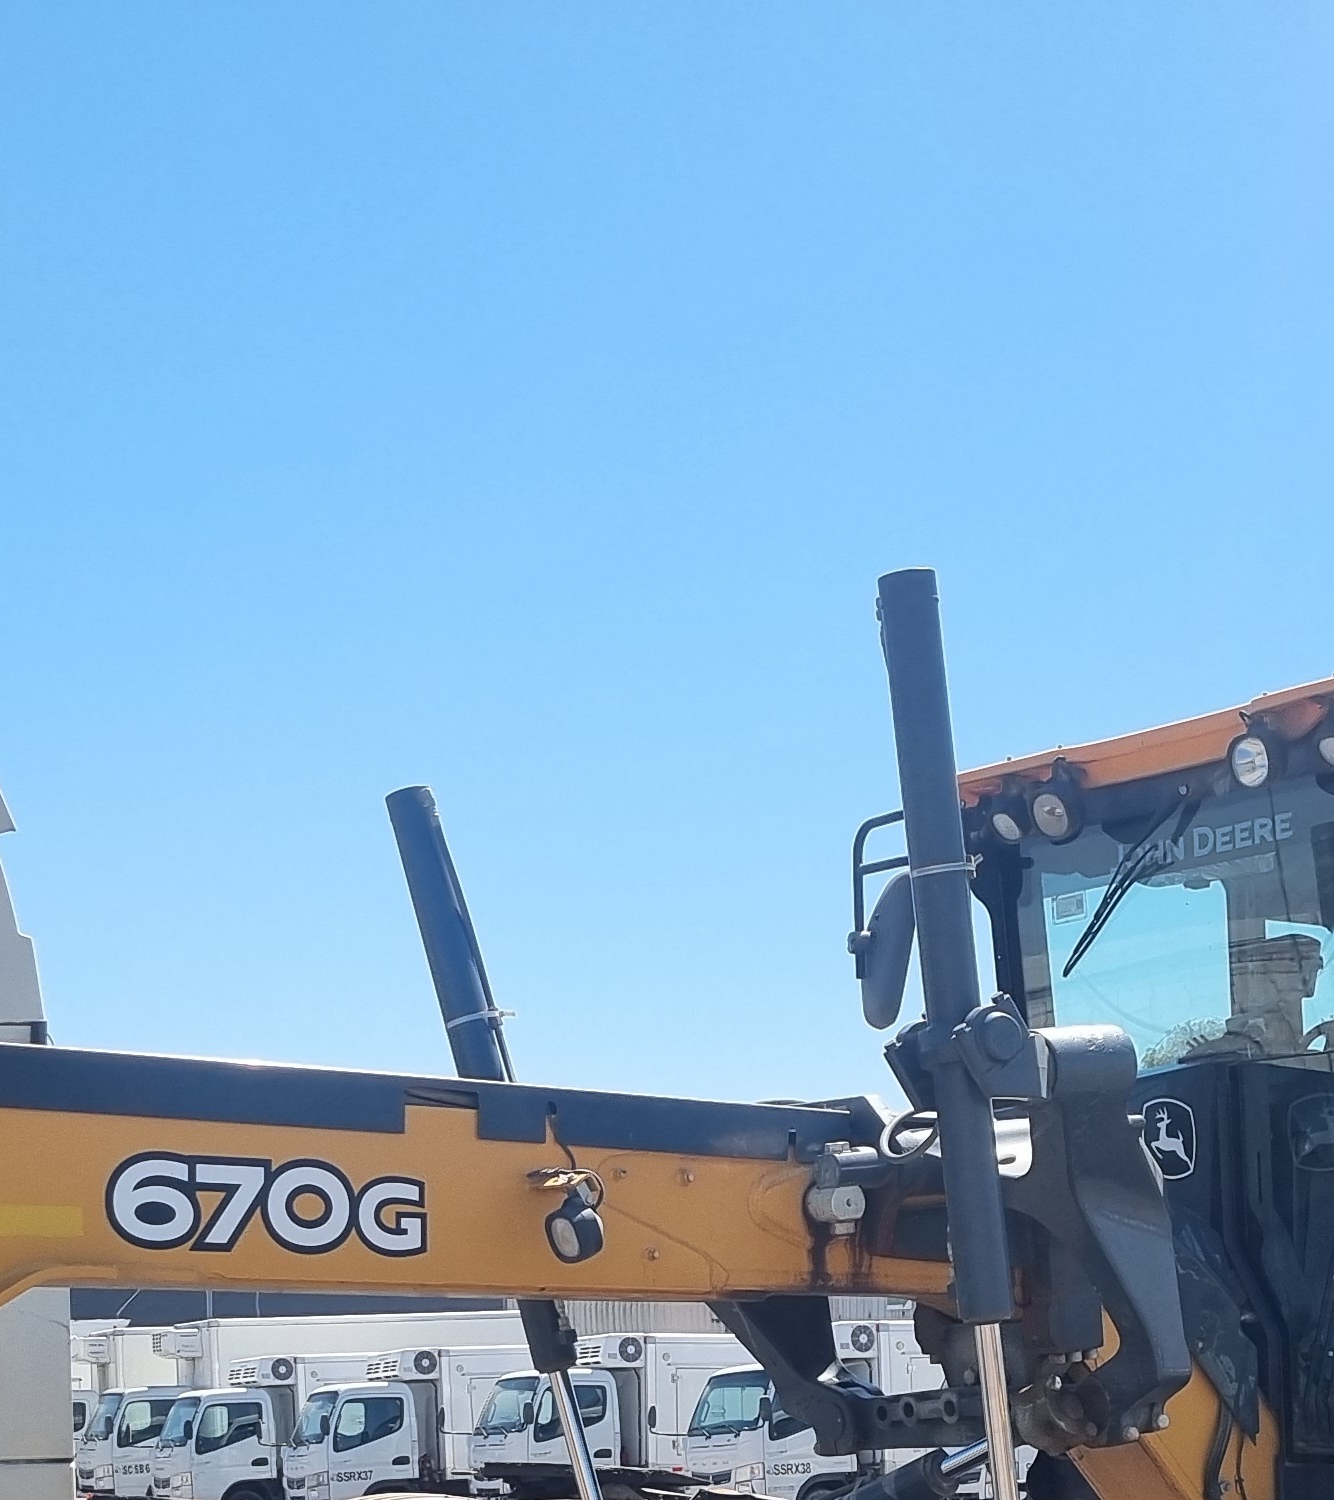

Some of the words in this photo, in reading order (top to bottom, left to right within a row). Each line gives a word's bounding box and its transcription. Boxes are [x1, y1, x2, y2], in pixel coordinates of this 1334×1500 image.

[1193, 812, 1294, 857] DEERE
[105, 1151, 428, 1257] 670G
[336, 1469, 374, 1482] SSRX37
[773, 1462, 812, 1475] SSRX38
